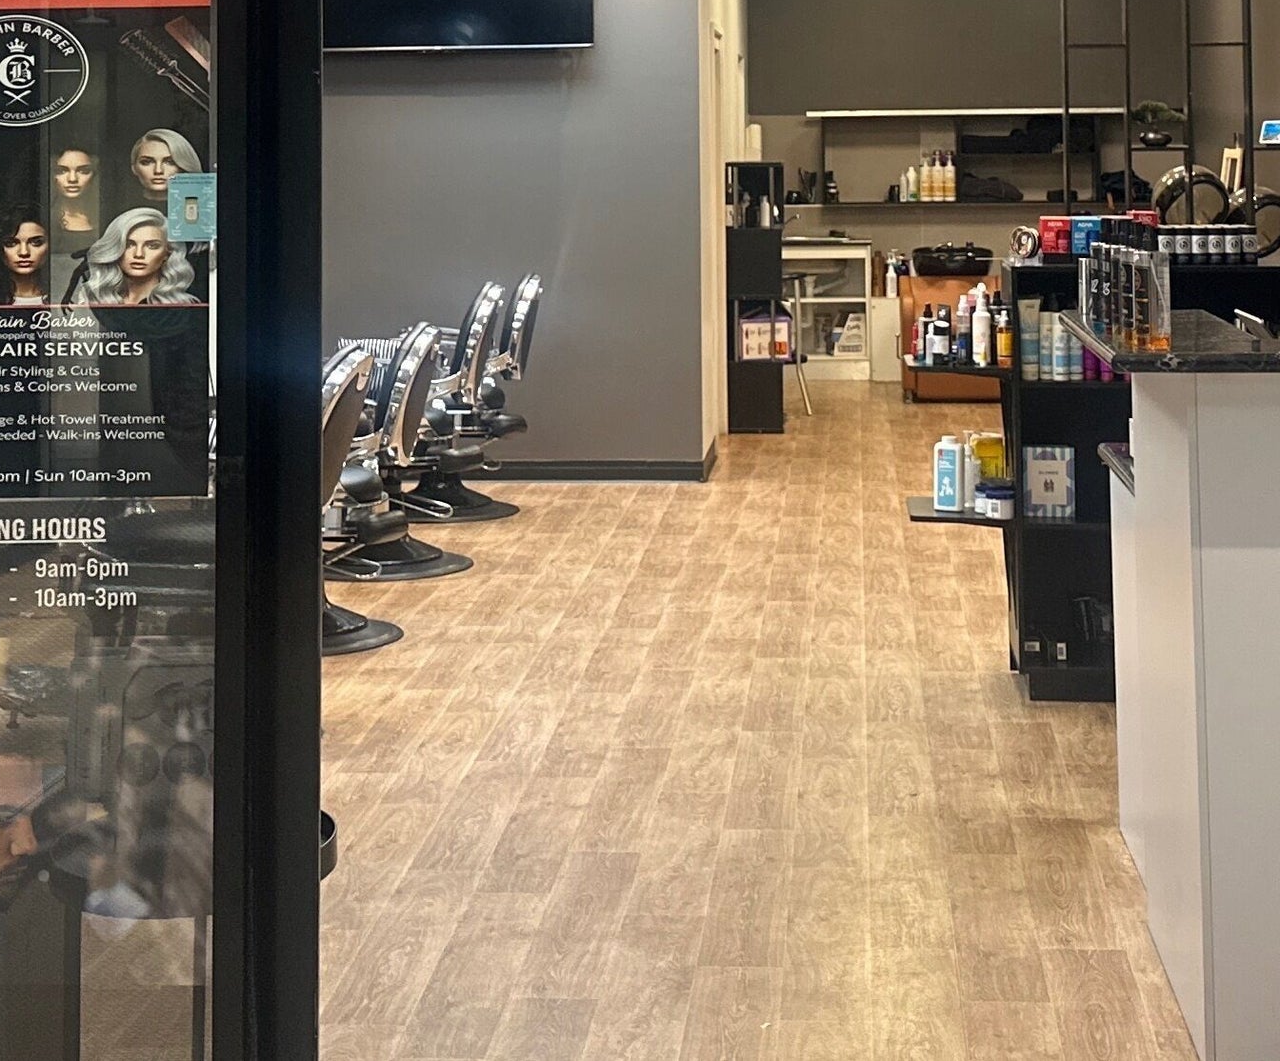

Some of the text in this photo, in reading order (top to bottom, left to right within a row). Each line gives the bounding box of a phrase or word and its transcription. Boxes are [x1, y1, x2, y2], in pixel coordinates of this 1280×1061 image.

[22, 22, 76, 56] BARBER
[2, 111, 27, 120] OVER
[29, 310, 96, 330] Barber
[72, 329, 127, 339] Palmerston
[44, 340, 144, 357] SERVICES
[10, 365, 54, 379] Styling
[56, 366, 67, 376] &
[70, 366, 100, 376] Cuts
[14, 381, 25, 392] &
[27, 381, 71, 392] Colors
[74, 380, 138, 392] Welcome
[17, 415, 28, 425] &
[31, 414, 55, 425] Hot
[59, 414, 97, 425] Towel
[100, 413, 166, 425] Treatment
[46, 428, 101, 440] Walk-ins
[104, 428, 165, 440] Welcome
[34, 470, 65, 482] Sun
[69, 469, 152, 483] 10am-3pm
[32, 516, 107, 540] HOURS
[34, 558, 129, 580] 9am-6pm
[34, 588, 137, 610] 10am-3pm
